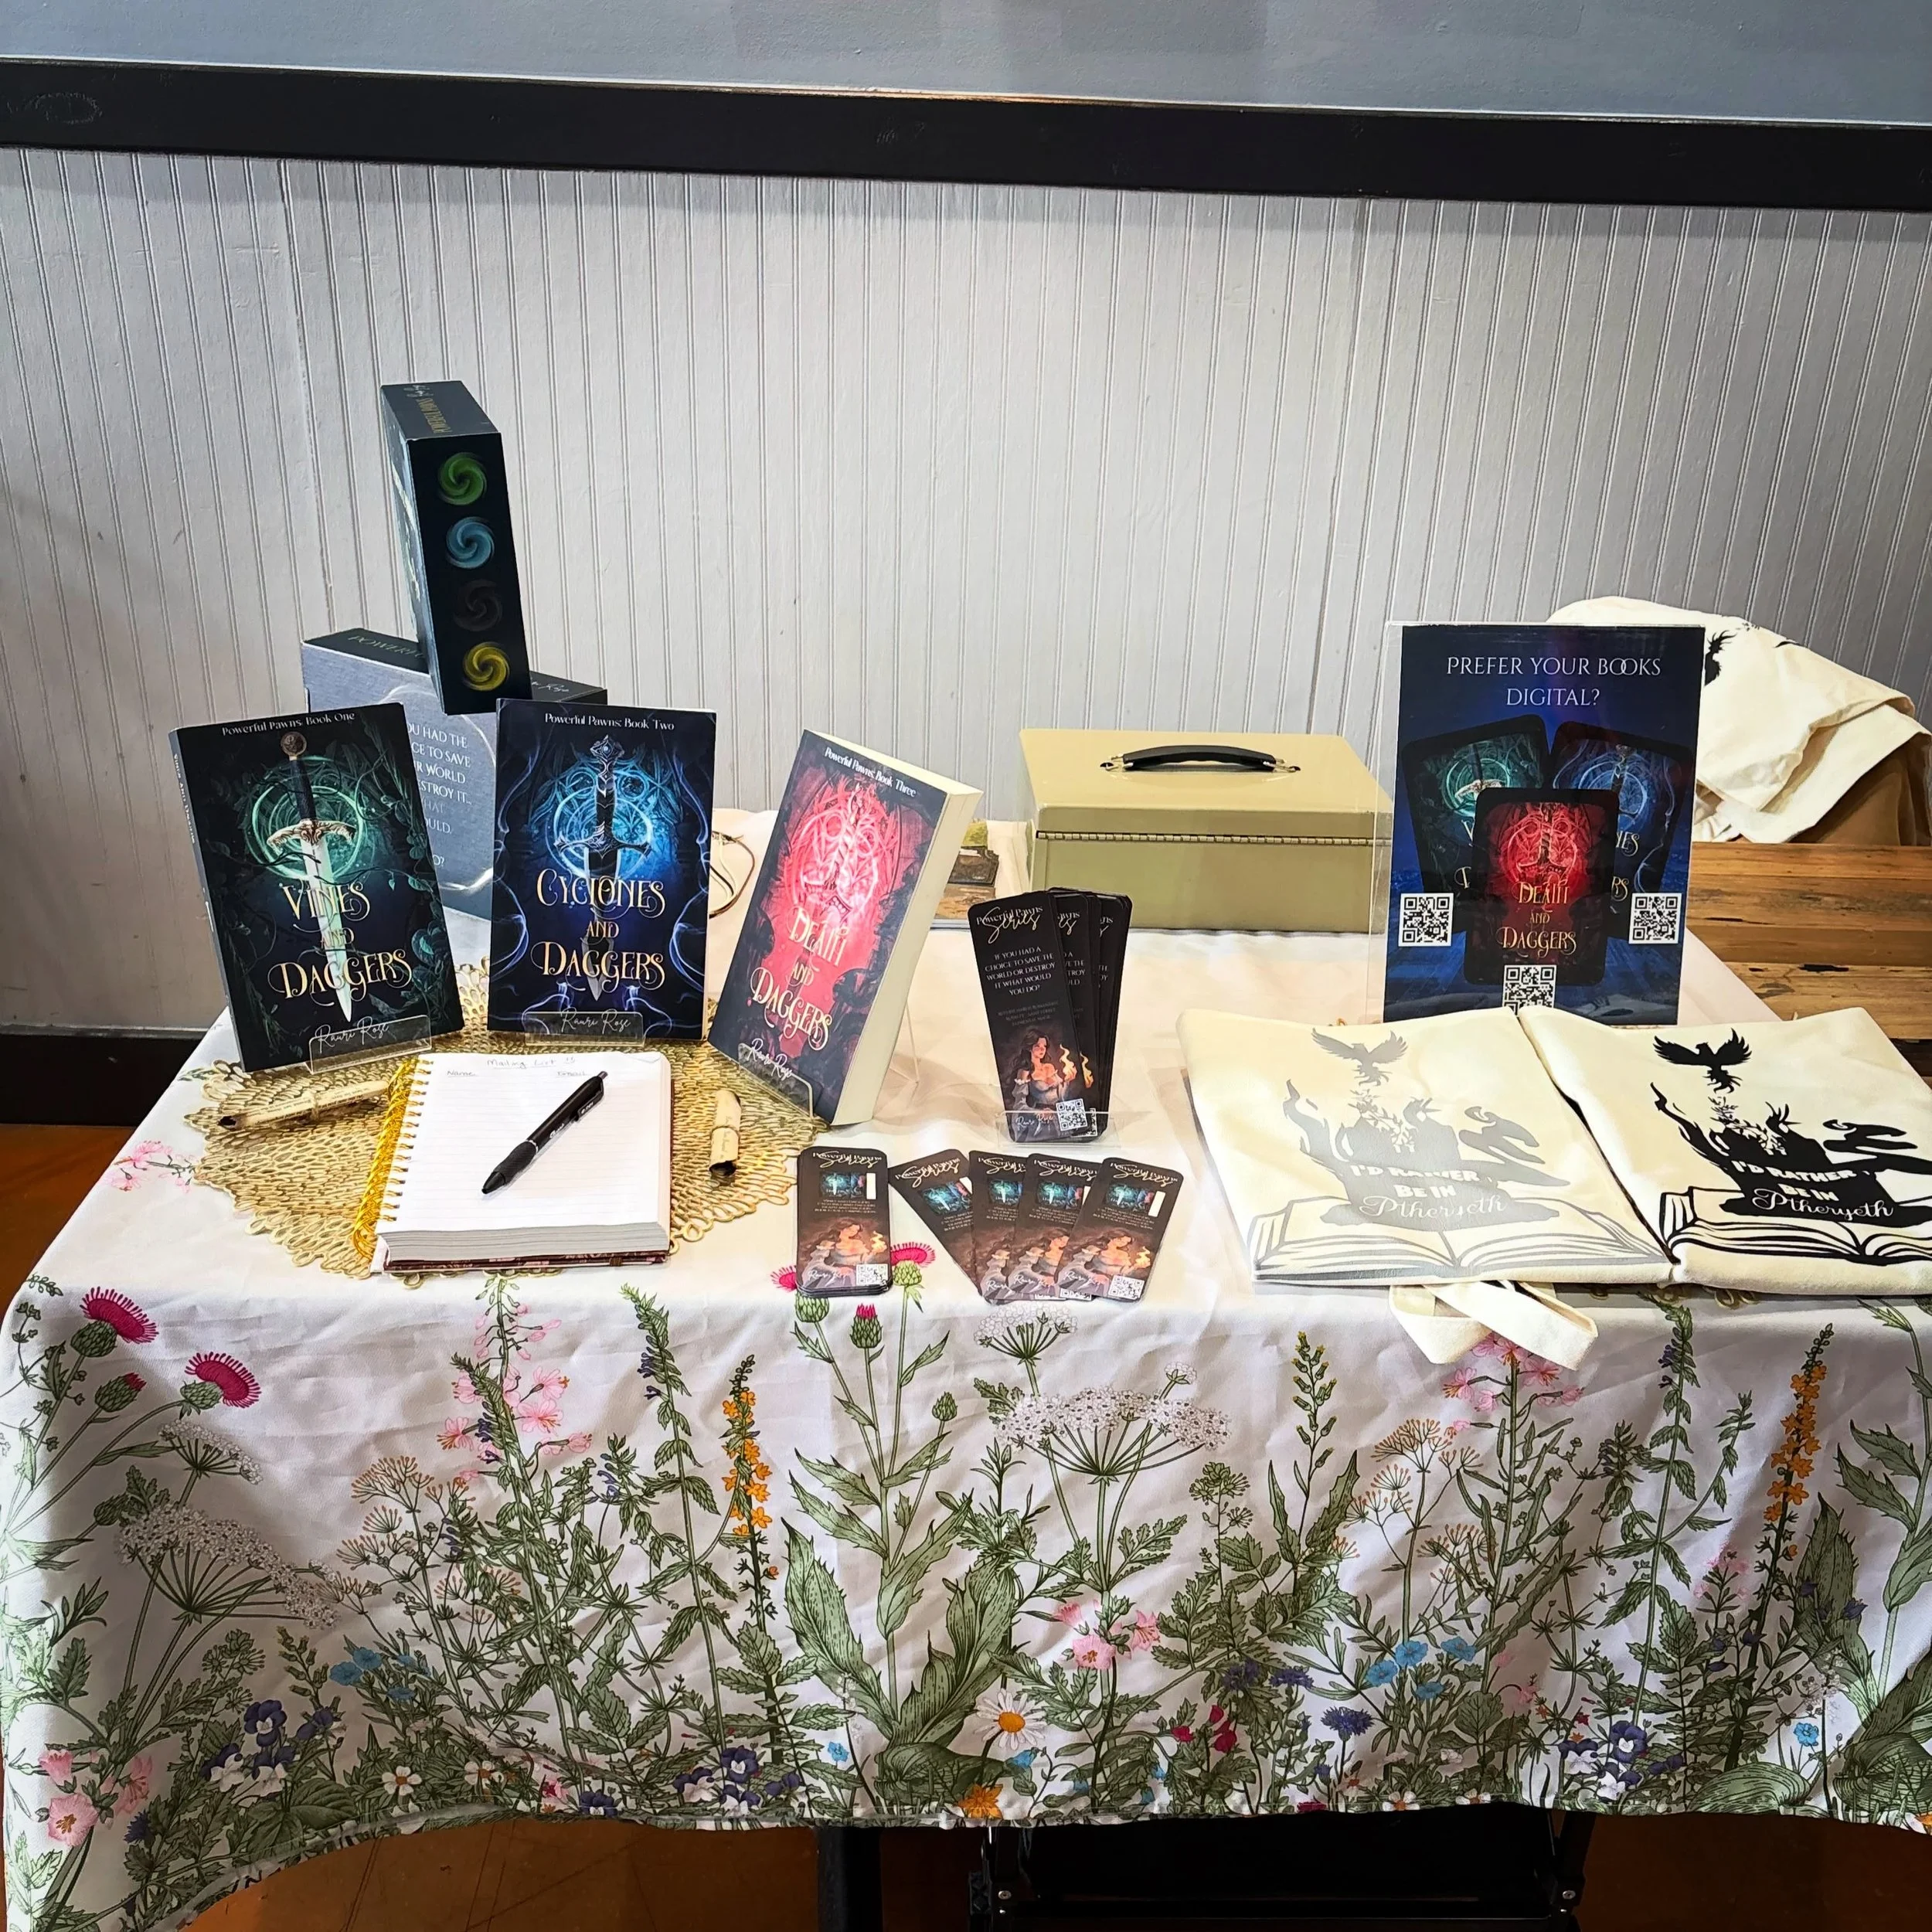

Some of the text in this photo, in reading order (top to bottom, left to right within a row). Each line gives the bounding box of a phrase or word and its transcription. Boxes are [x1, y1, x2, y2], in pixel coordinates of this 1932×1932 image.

[1447, 657, 1661, 676] PREFER YOUR BOOKS
[1507, 688, 1600, 706] DIGITAL?
[222, 722, 267, 736] Powerful
[306, 715, 332, 726] Book
[334, 712, 355, 723] One
[545, 713, 586, 725] Powerful
[624, 718, 649, 730] Book
[652, 719, 675, 730] Two
[423, 726, 447, 743] HAD
[449, 733, 468, 749] THE
[427, 747, 443, 760] TO
[445, 751, 471, 768] SAVE
[426, 763, 466, 784] WORLD
[825, 747, 853, 768] Powerful
[876, 770, 894, 787] Book
[896, 778, 917, 798] Three
[537, 869, 665, 919] CYCLONES
[1512, 880, 1570, 904] DEATH
[282, 882, 370, 927] VINES
[977, 906, 1043, 925] Powerful Pawns
[982, 906, 1041, 944] Series
[1529, 912, 1550, 924] AND
[321, 927, 355, 947] AND
[583, 921, 619, 942] AND
[787, 906, 849, 966] DEATH
[1496, 927, 1577, 957] DAGGERS
[1002, 951, 1017, 959] YOU
[1019, 947, 1035, 956] HAD
[267, 949, 412, 1005] DAGGERS
[530, 941, 665, 992] DAGGERS
[787, 962, 815, 986] AND
[985, 961, 1011, 972] CHOICE
[986, 971, 1012, 981] WORLD
[1025, 962, 1056, 974] DESTROY
[1002, 978, 1024, 987] WHAT
[1025, 973, 1052, 983] WOULD
[1009, 987, 1025, 995] YOU
[750, 967, 832, 1050] DAGGERS
[601, 1009, 631, 1034] Rose
[487, 1060, 527, 1070] Mailing
[1350, 1165, 1383, 1177] I'D
[1731, 1161, 1857, 1182] I'D RATHER
[1393, 1185, 1456, 1198] BE IN
[1778, 1183, 1839, 1202] BE IN
[1753, 1188, 1893, 1220] Ptheryeth
